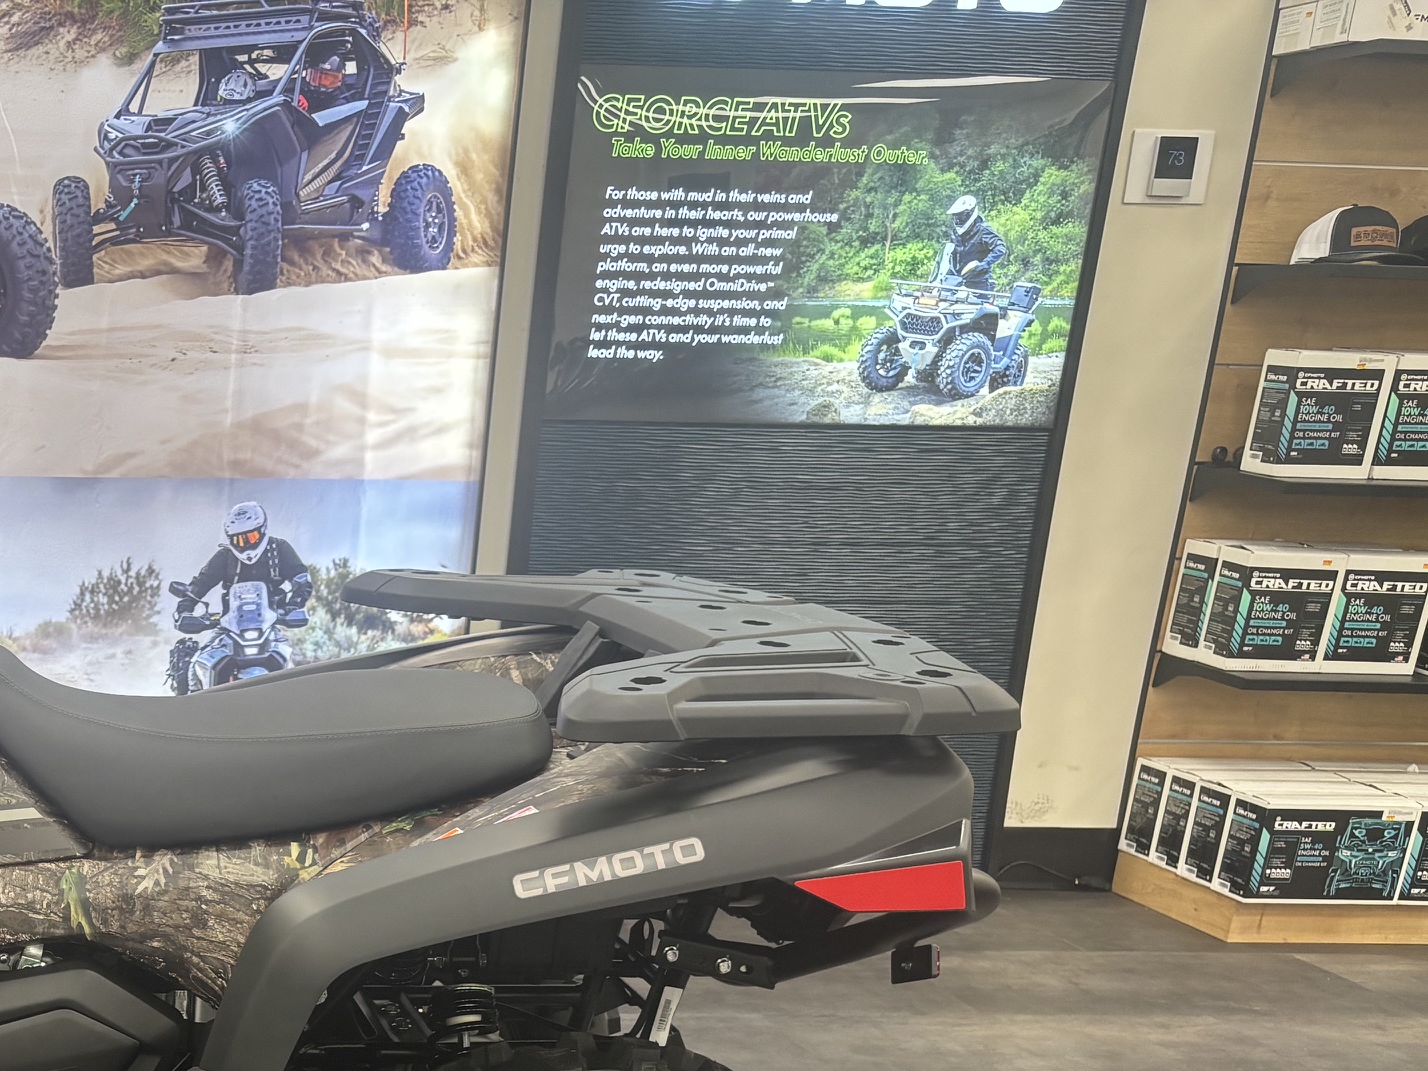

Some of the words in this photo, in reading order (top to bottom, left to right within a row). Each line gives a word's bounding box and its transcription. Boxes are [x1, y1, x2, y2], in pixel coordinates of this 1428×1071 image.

[592, 94, 754, 136] CFORCE
[750, 100, 852, 138] ATVs
[612, 138, 655, 158] Take
[660, 138, 702, 159] Your
[704, 140, 756, 160] Inner
[759, 140, 868, 164] Wanderlust
[871, 144, 930, 165] Outer.
[1168, 150, 1184, 166] 73
[605, 186, 626, 200] For
[626, 186, 658, 200] those
[660, 188, 685, 201] with
[687, 188, 714, 202] mud
[714, 190, 726, 202] in
[728, 189, 756, 202] their
[756, 190, 786, 203] veins
[788, 190, 813, 204] and
[602, 204, 662, 218] adventure
[664, 206, 676, 218] in
[678, 206, 706, 220] their
[706, 206, 744, 222] hearts,
[747, 211, 768, 221] our
[768, 208, 838, 224] powerhouse
[600, 222, 630, 236] ATVs
[632, 226, 652, 236] are
[654, 223, 680, 237] here
[682, 226, 694, 238] to
[696, 226, 730, 241] ignite
[730, 228, 758, 241] your
[758, 226, 798, 242] primal
[600, 244, 626, 256] urge
[628, 242, 640, 254] to
[642, 242, 689, 257] explore.
[692, 242, 718, 256] With
[721, 246, 736, 256] an
[738, 244, 783, 257] all-new
[596, 258, 650, 274] platform,
[652, 262, 668, 272] an
[670, 263, 697, 273] even
[698, 264, 728, 274] more
[730, 262, 783, 277] powerful
[595, 278, 638, 292] engine,
[640, 277, 704, 294] redesigned
[594, 294, 620, 308] CVT,
[622, 295, 696, 311] cutting-edge
[698, 298, 762, 312] suspension,
[763, 297, 788, 310] and
[592, 312, 643, 328] next-gen
[645, 314, 714, 329] connectivity
[715, 314, 730, 326] it's
[732, 314, 757, 326] time
[760, 316, 772, 327] to
[590, 328, 606, 341] let
[607, 328, 638, 342] these
[638, 330, 667, 342] ATVs
[668, 330, 694, 343] and
[693, 332, 720, 346] your
[722, 332, 784, 344] wanderlust
[588, 345, 615, 358] lead
[616, 346, 635, 358] the
[637, 350, 664, 362] way.
[1296, 379, 1379, 390] CRAFTED
[1250, 578, 1334, 591] CRAFTED
[1345, 581, 1428, 592] CRAFTED
[1253, 603, 1290, 612] 10W-40
[1274, 822, 1336, 830] CRAFTED
[512, 836, 705, 899] CFMOTO
